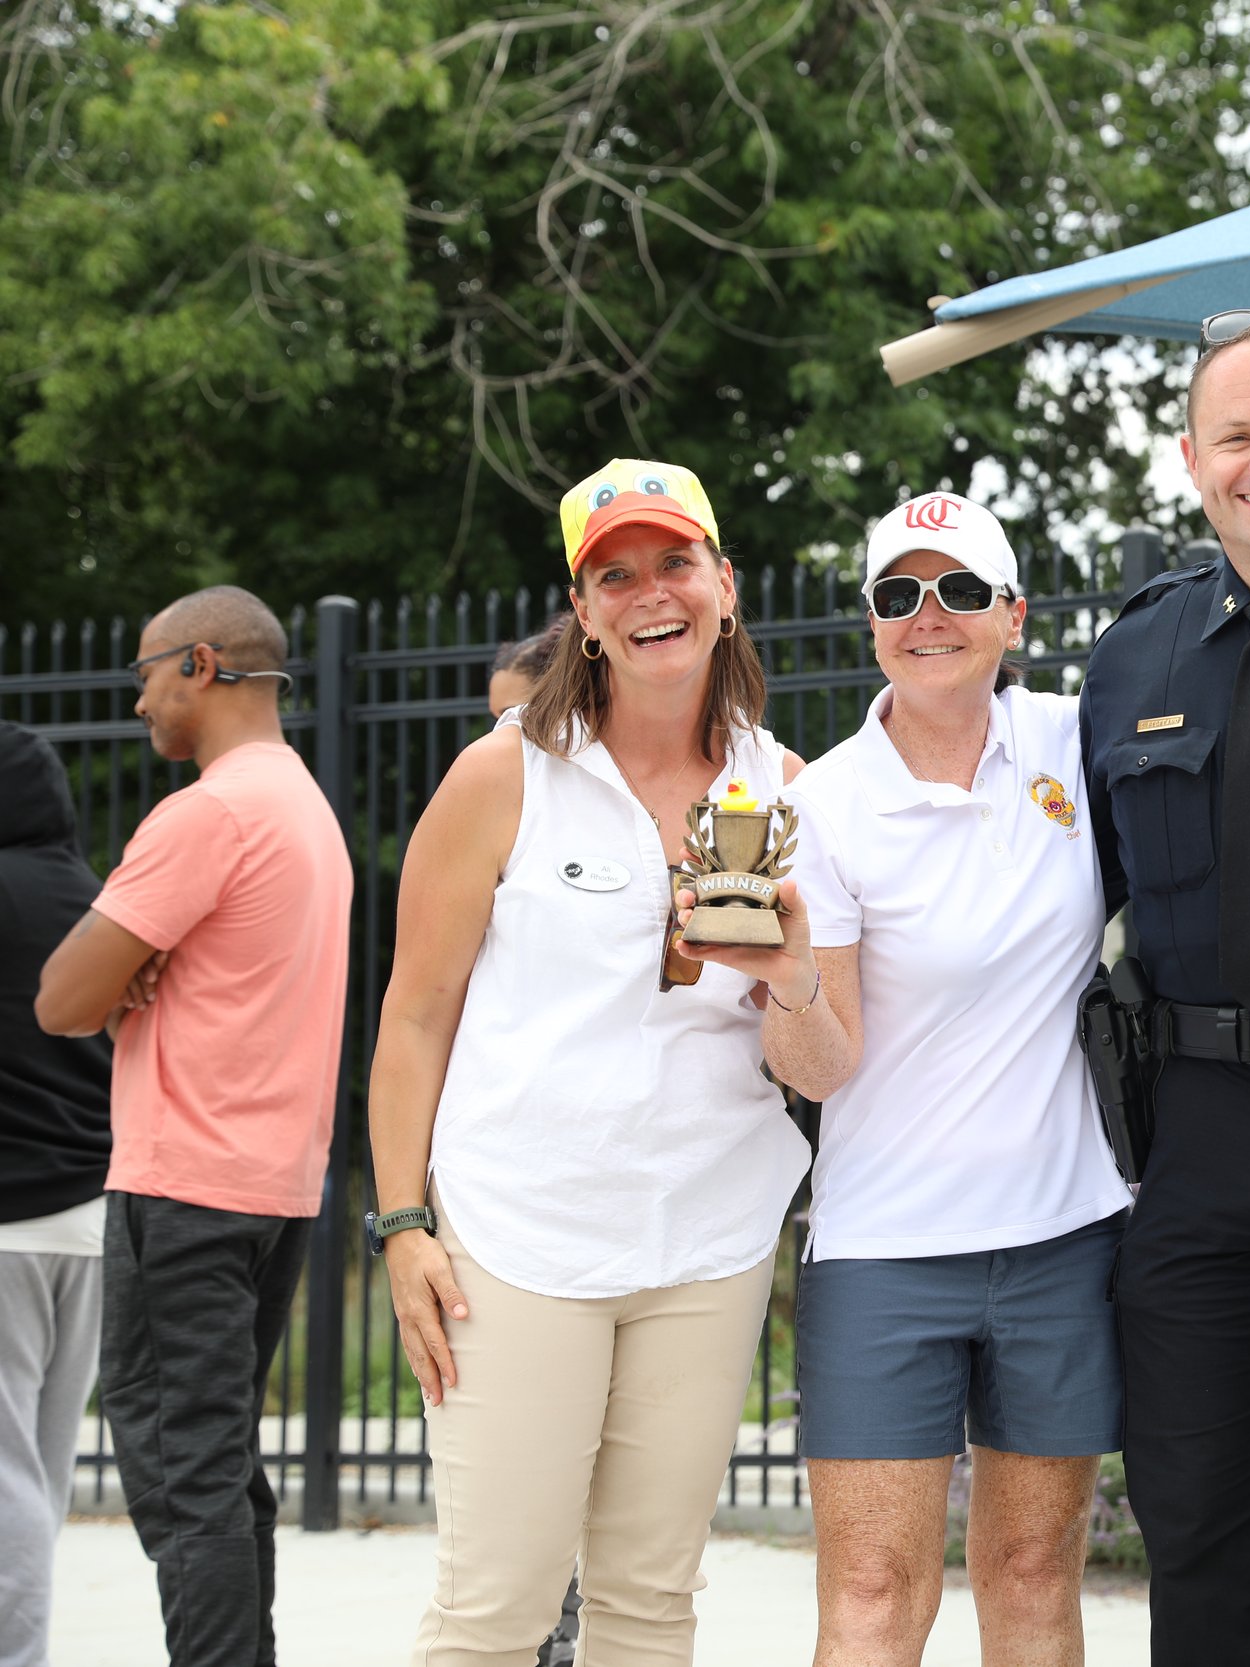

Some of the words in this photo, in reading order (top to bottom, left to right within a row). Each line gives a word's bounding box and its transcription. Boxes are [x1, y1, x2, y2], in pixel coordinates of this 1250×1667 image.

[1067, 830, 1081, 841] Chief
[590, 873, 619, 883] Rhodes
[699, 877, 774, 899] WINNER
